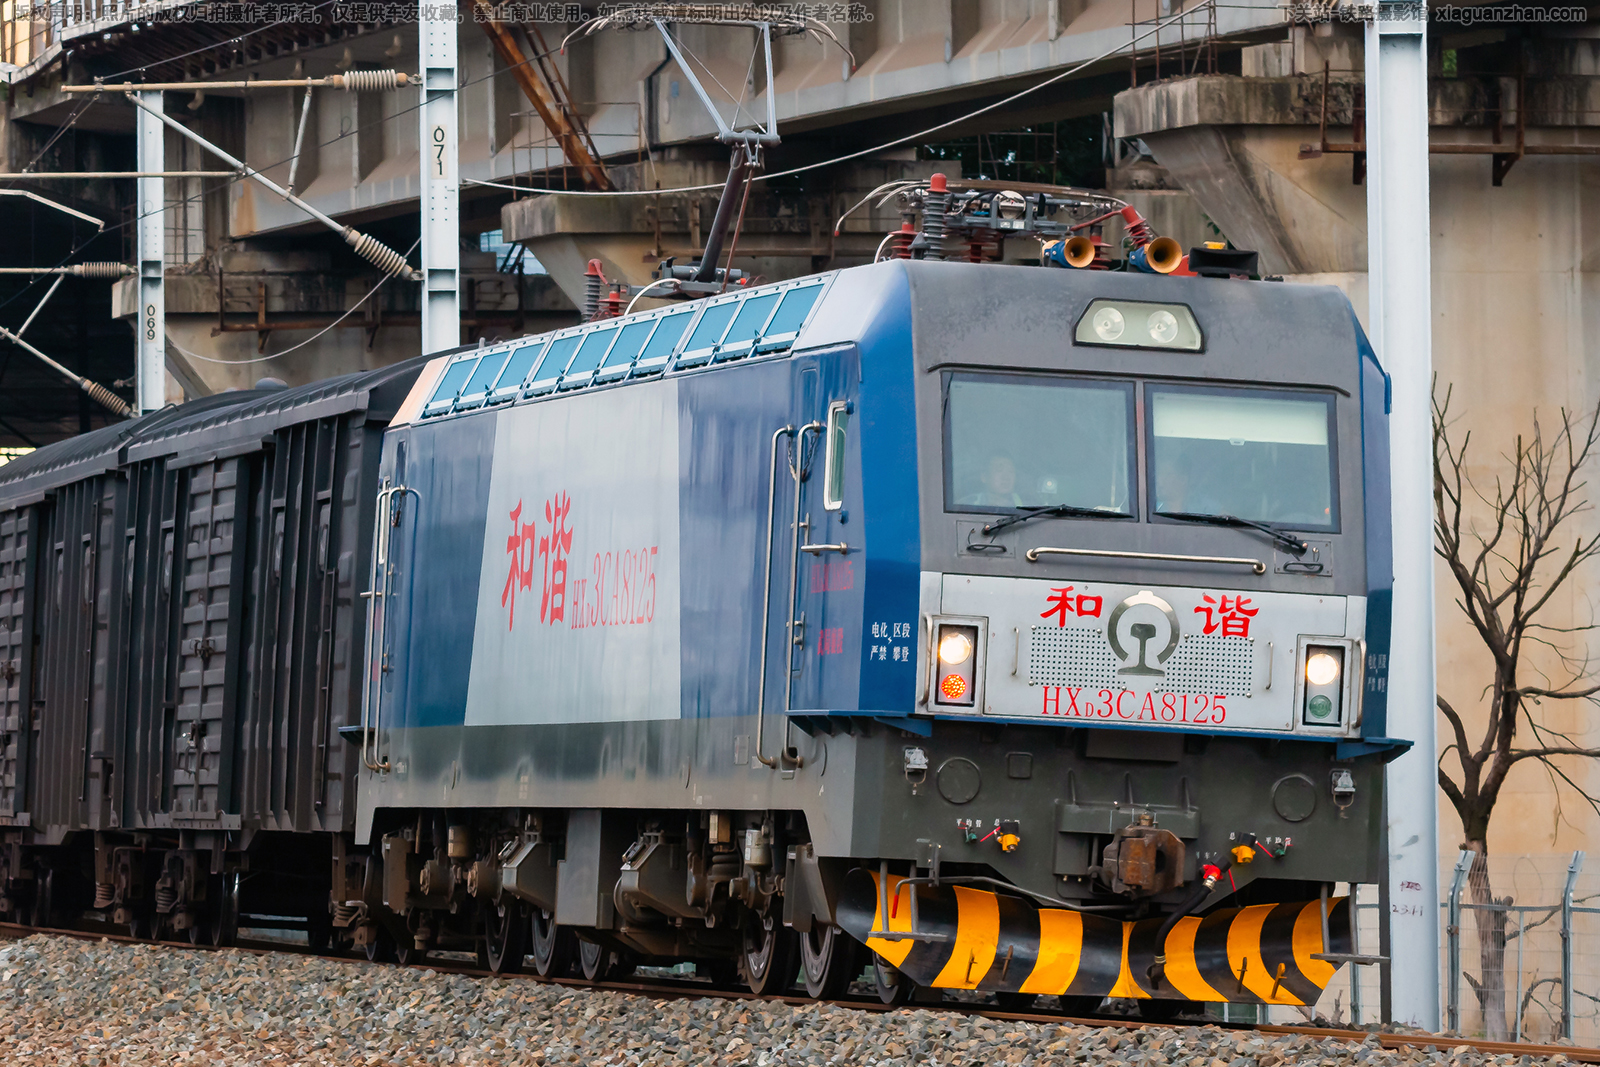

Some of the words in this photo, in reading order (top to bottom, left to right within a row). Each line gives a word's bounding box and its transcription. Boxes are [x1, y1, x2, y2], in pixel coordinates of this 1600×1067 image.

[433, 126, 445, 175] 071
[146, 304, 156, 341] 069
[501, 489, 574, 632] 和谐
[1040, 585, 1103, 628] 和
[1193, 594, 1260, 638] 谐
[1041, 686, 1227, 724] HXD3CA8125
